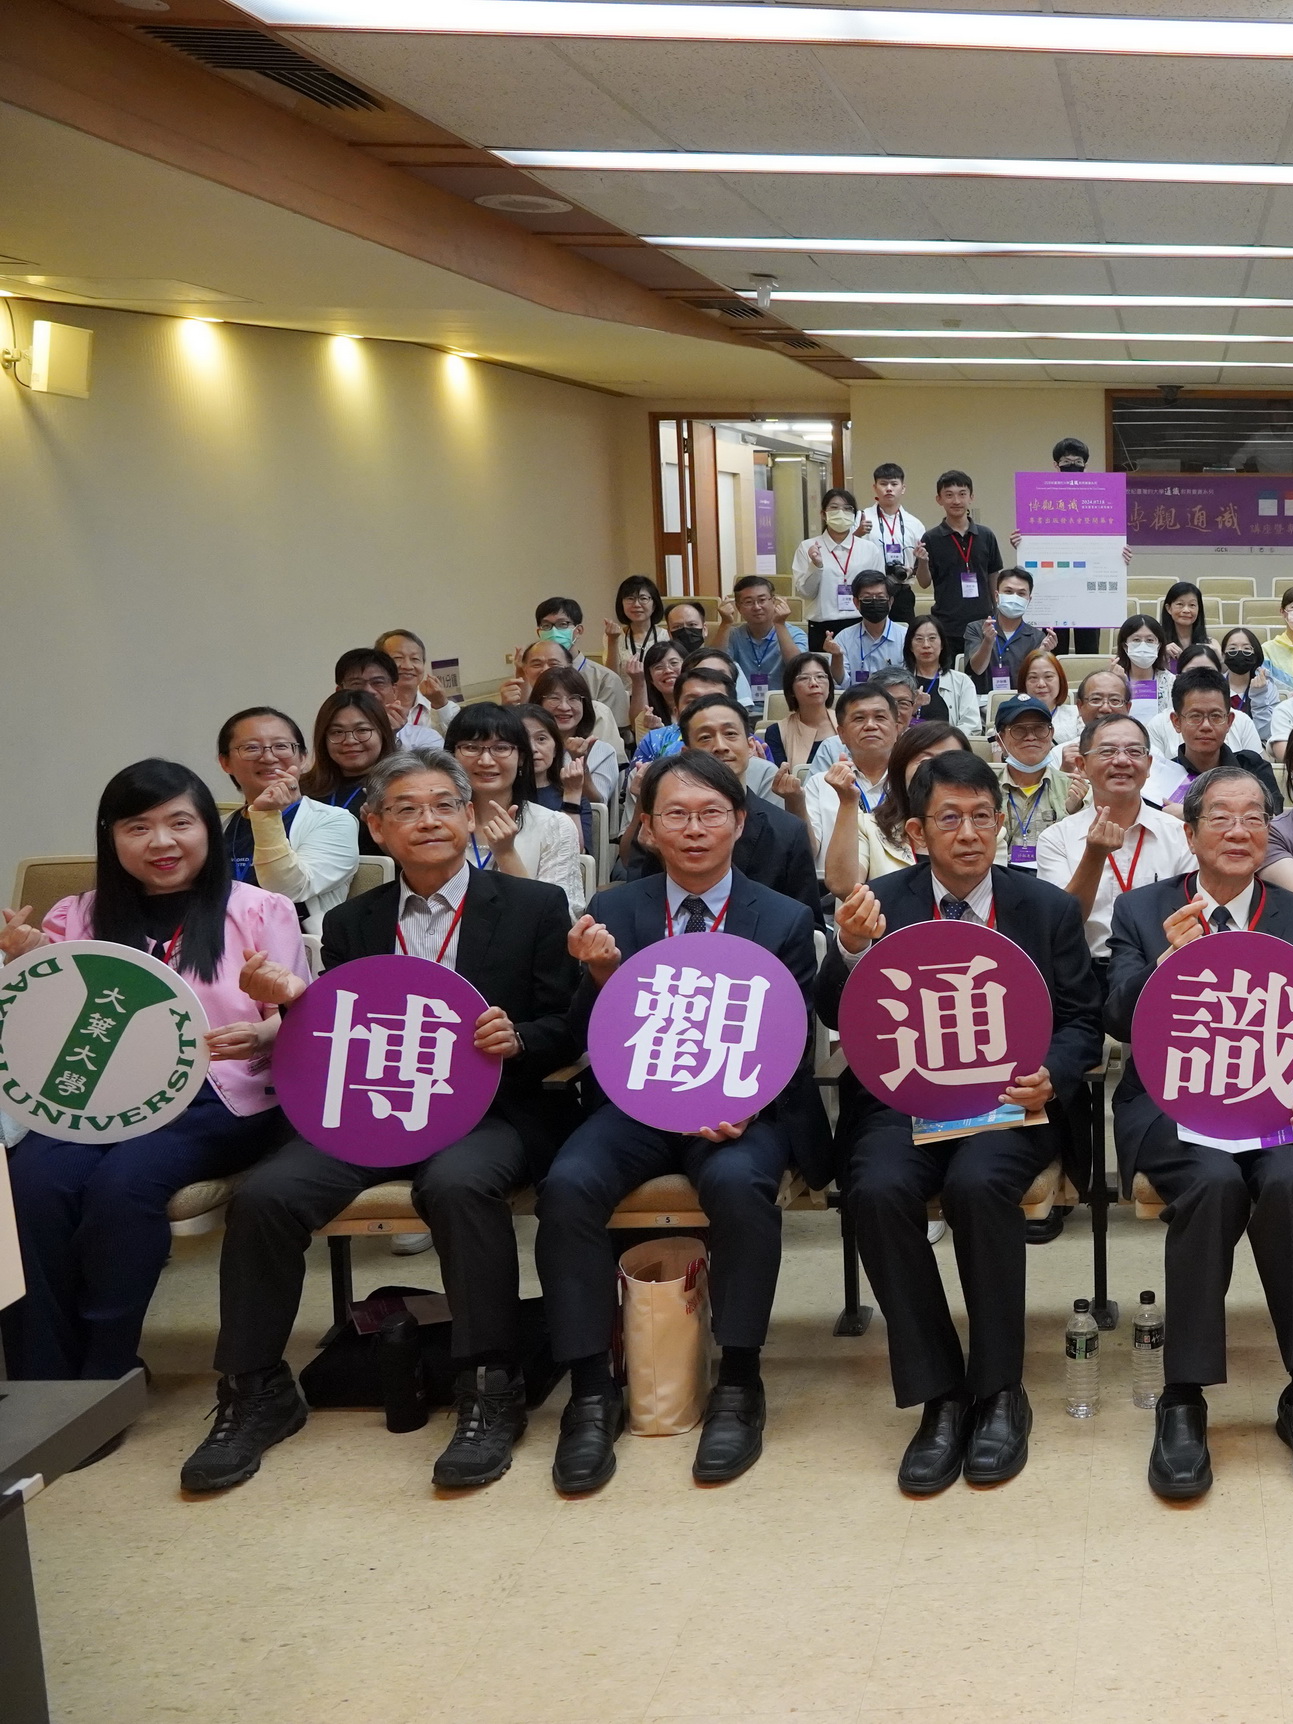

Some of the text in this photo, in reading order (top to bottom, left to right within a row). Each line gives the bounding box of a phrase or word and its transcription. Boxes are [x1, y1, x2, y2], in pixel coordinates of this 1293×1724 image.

[2, 1007, 197, 1132] UNIVERSITY
[55, 987, 127, 1096] 大葉大學
[313, 989, 462, 1131] 博
[623, 964, 771, 1098] 觀
[877, 955, 1018, 1092] 通
